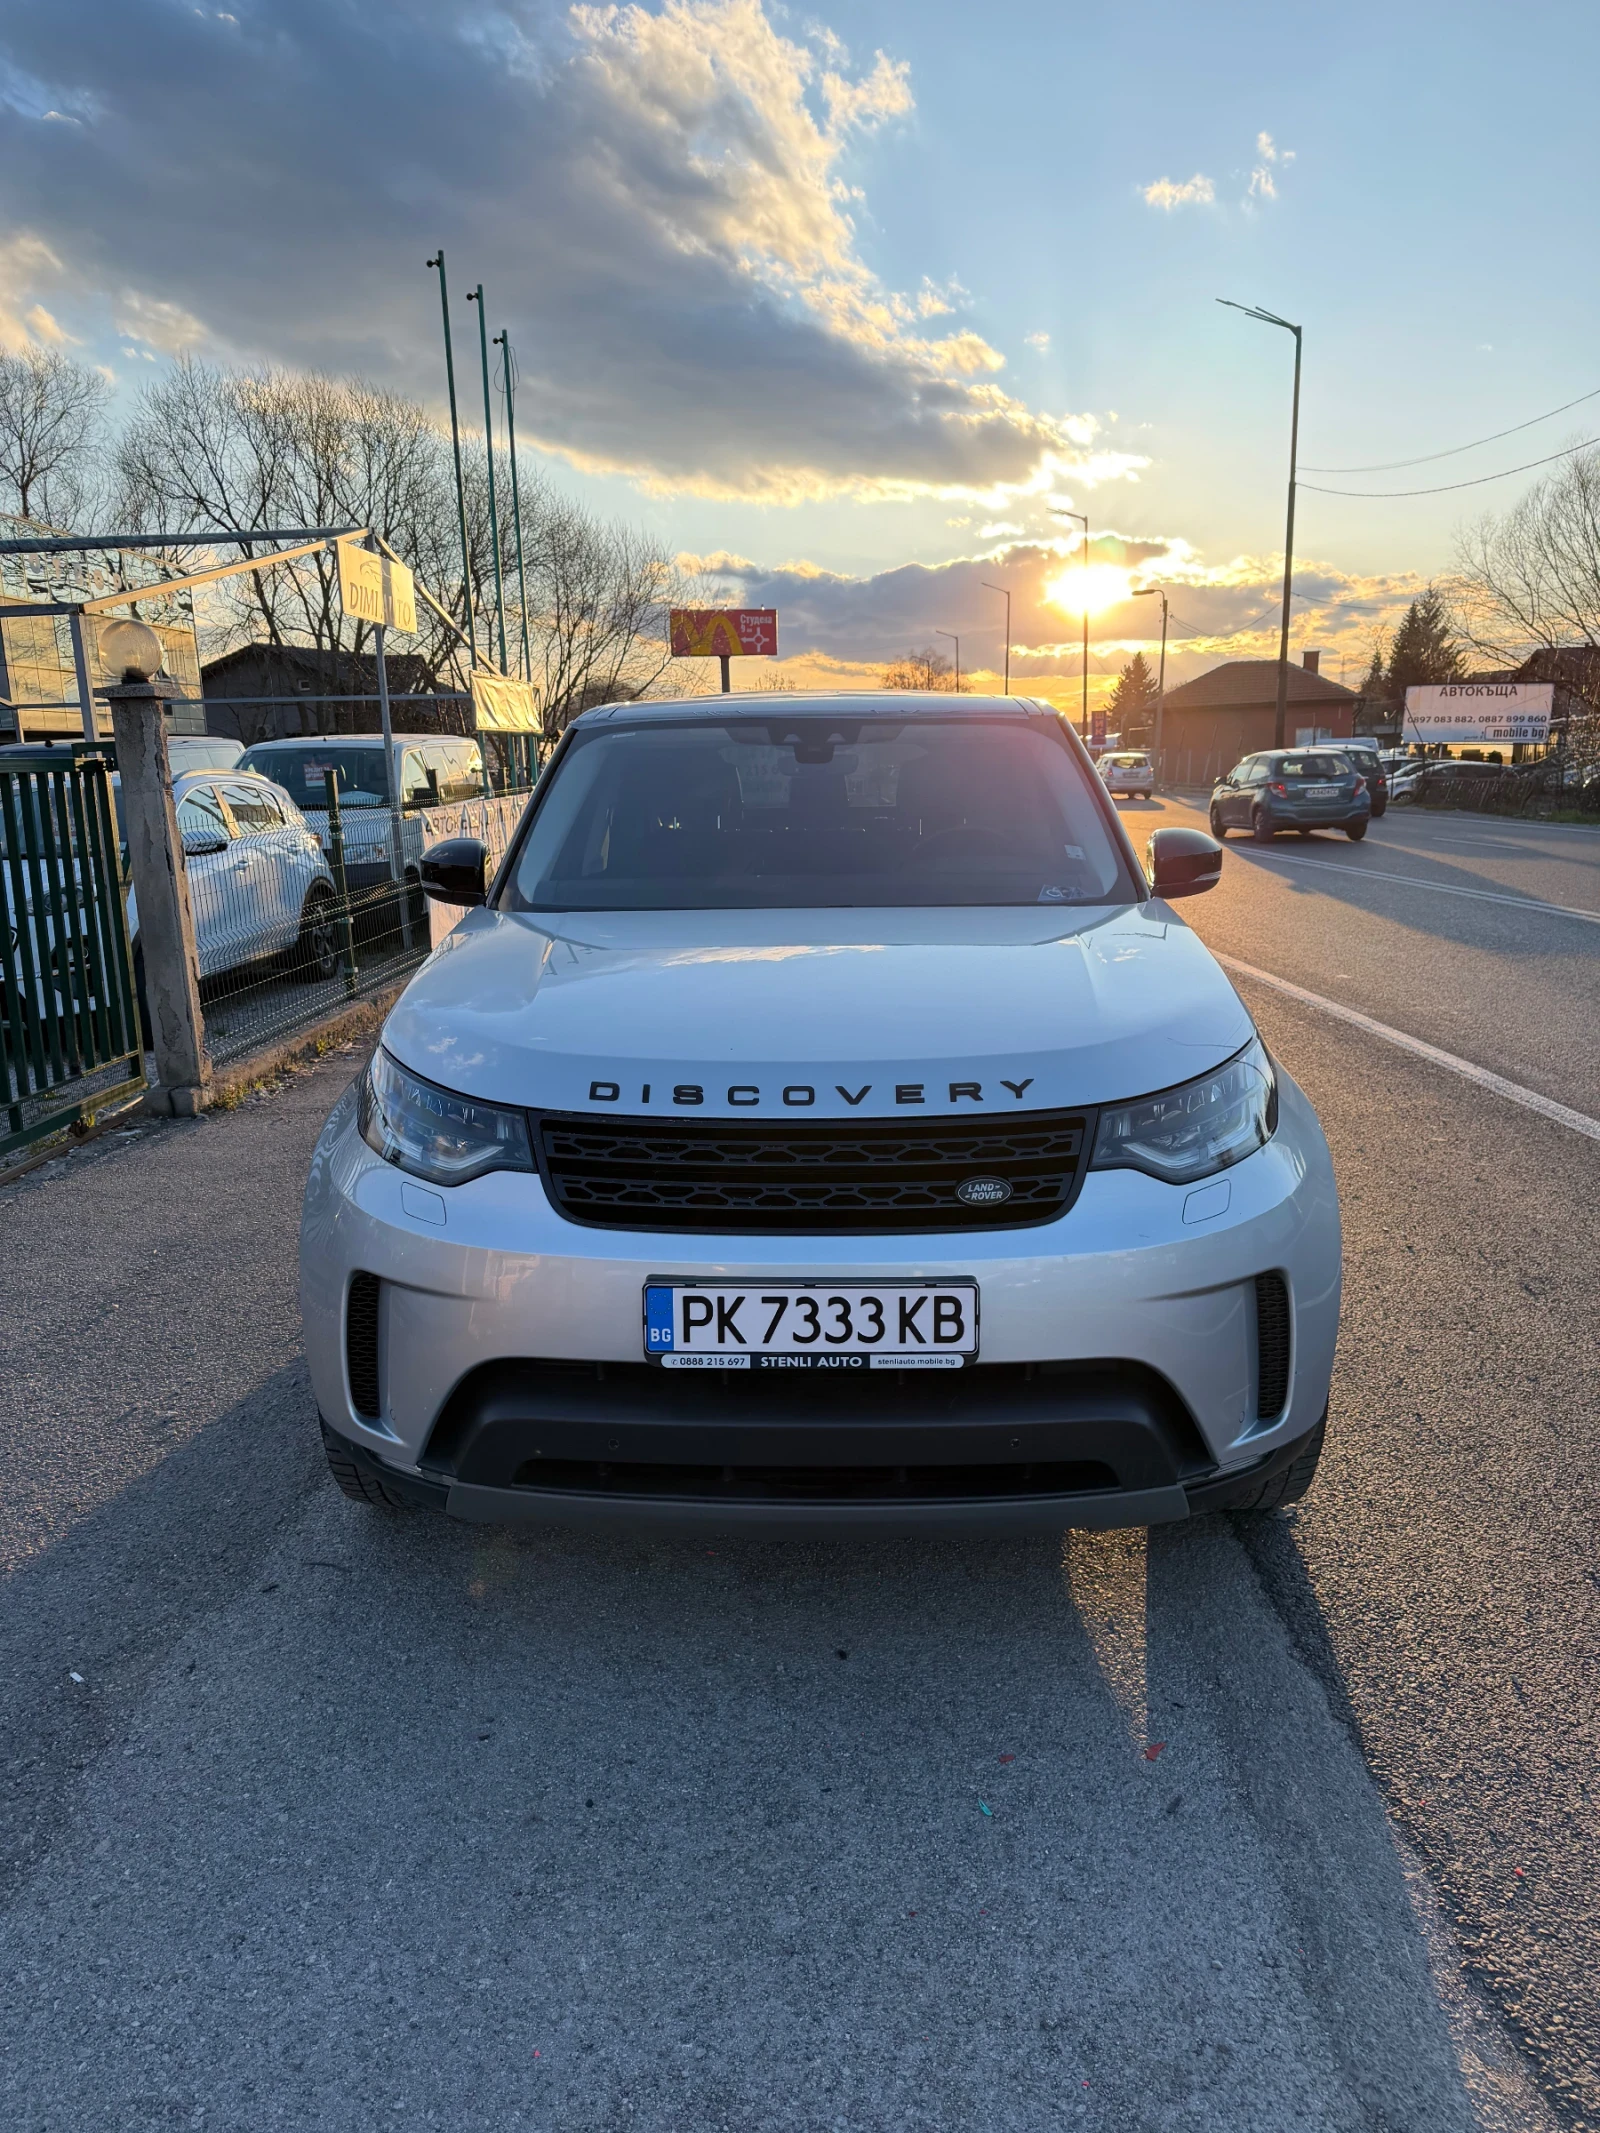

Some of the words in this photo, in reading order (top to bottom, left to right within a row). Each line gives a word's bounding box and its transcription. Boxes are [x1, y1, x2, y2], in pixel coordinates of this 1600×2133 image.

[350, 582, 379, 618] DIMI
[1439, 685, 1518, 699] АВТОКЪЩА
[1407, 716, 1431, 724] 0897
[1433, 716, 1452, 724] 083
[1454, 716, 1476, 724] 882,
[1478, 715, 1504, 723] 0887
[1506, 715, 1526, 723] 899
[1527, 715, 1547, 723] 860
[589, 1079, 1035, 1107] DISCOVERY
[968, 1183, 994, 1193] LAND
[971, 1191, 1003, 1200] ROVER
[650, 1328, 671, 1342] BG
[680, 1358, 703, 1366] 0888
[707, 1358, 724, 1366] 215
[728, 1358, 745, 1366] 697
[760, 1357, 812, 1367] STENLI
[817, 1357, 862, 1367] AUTO
